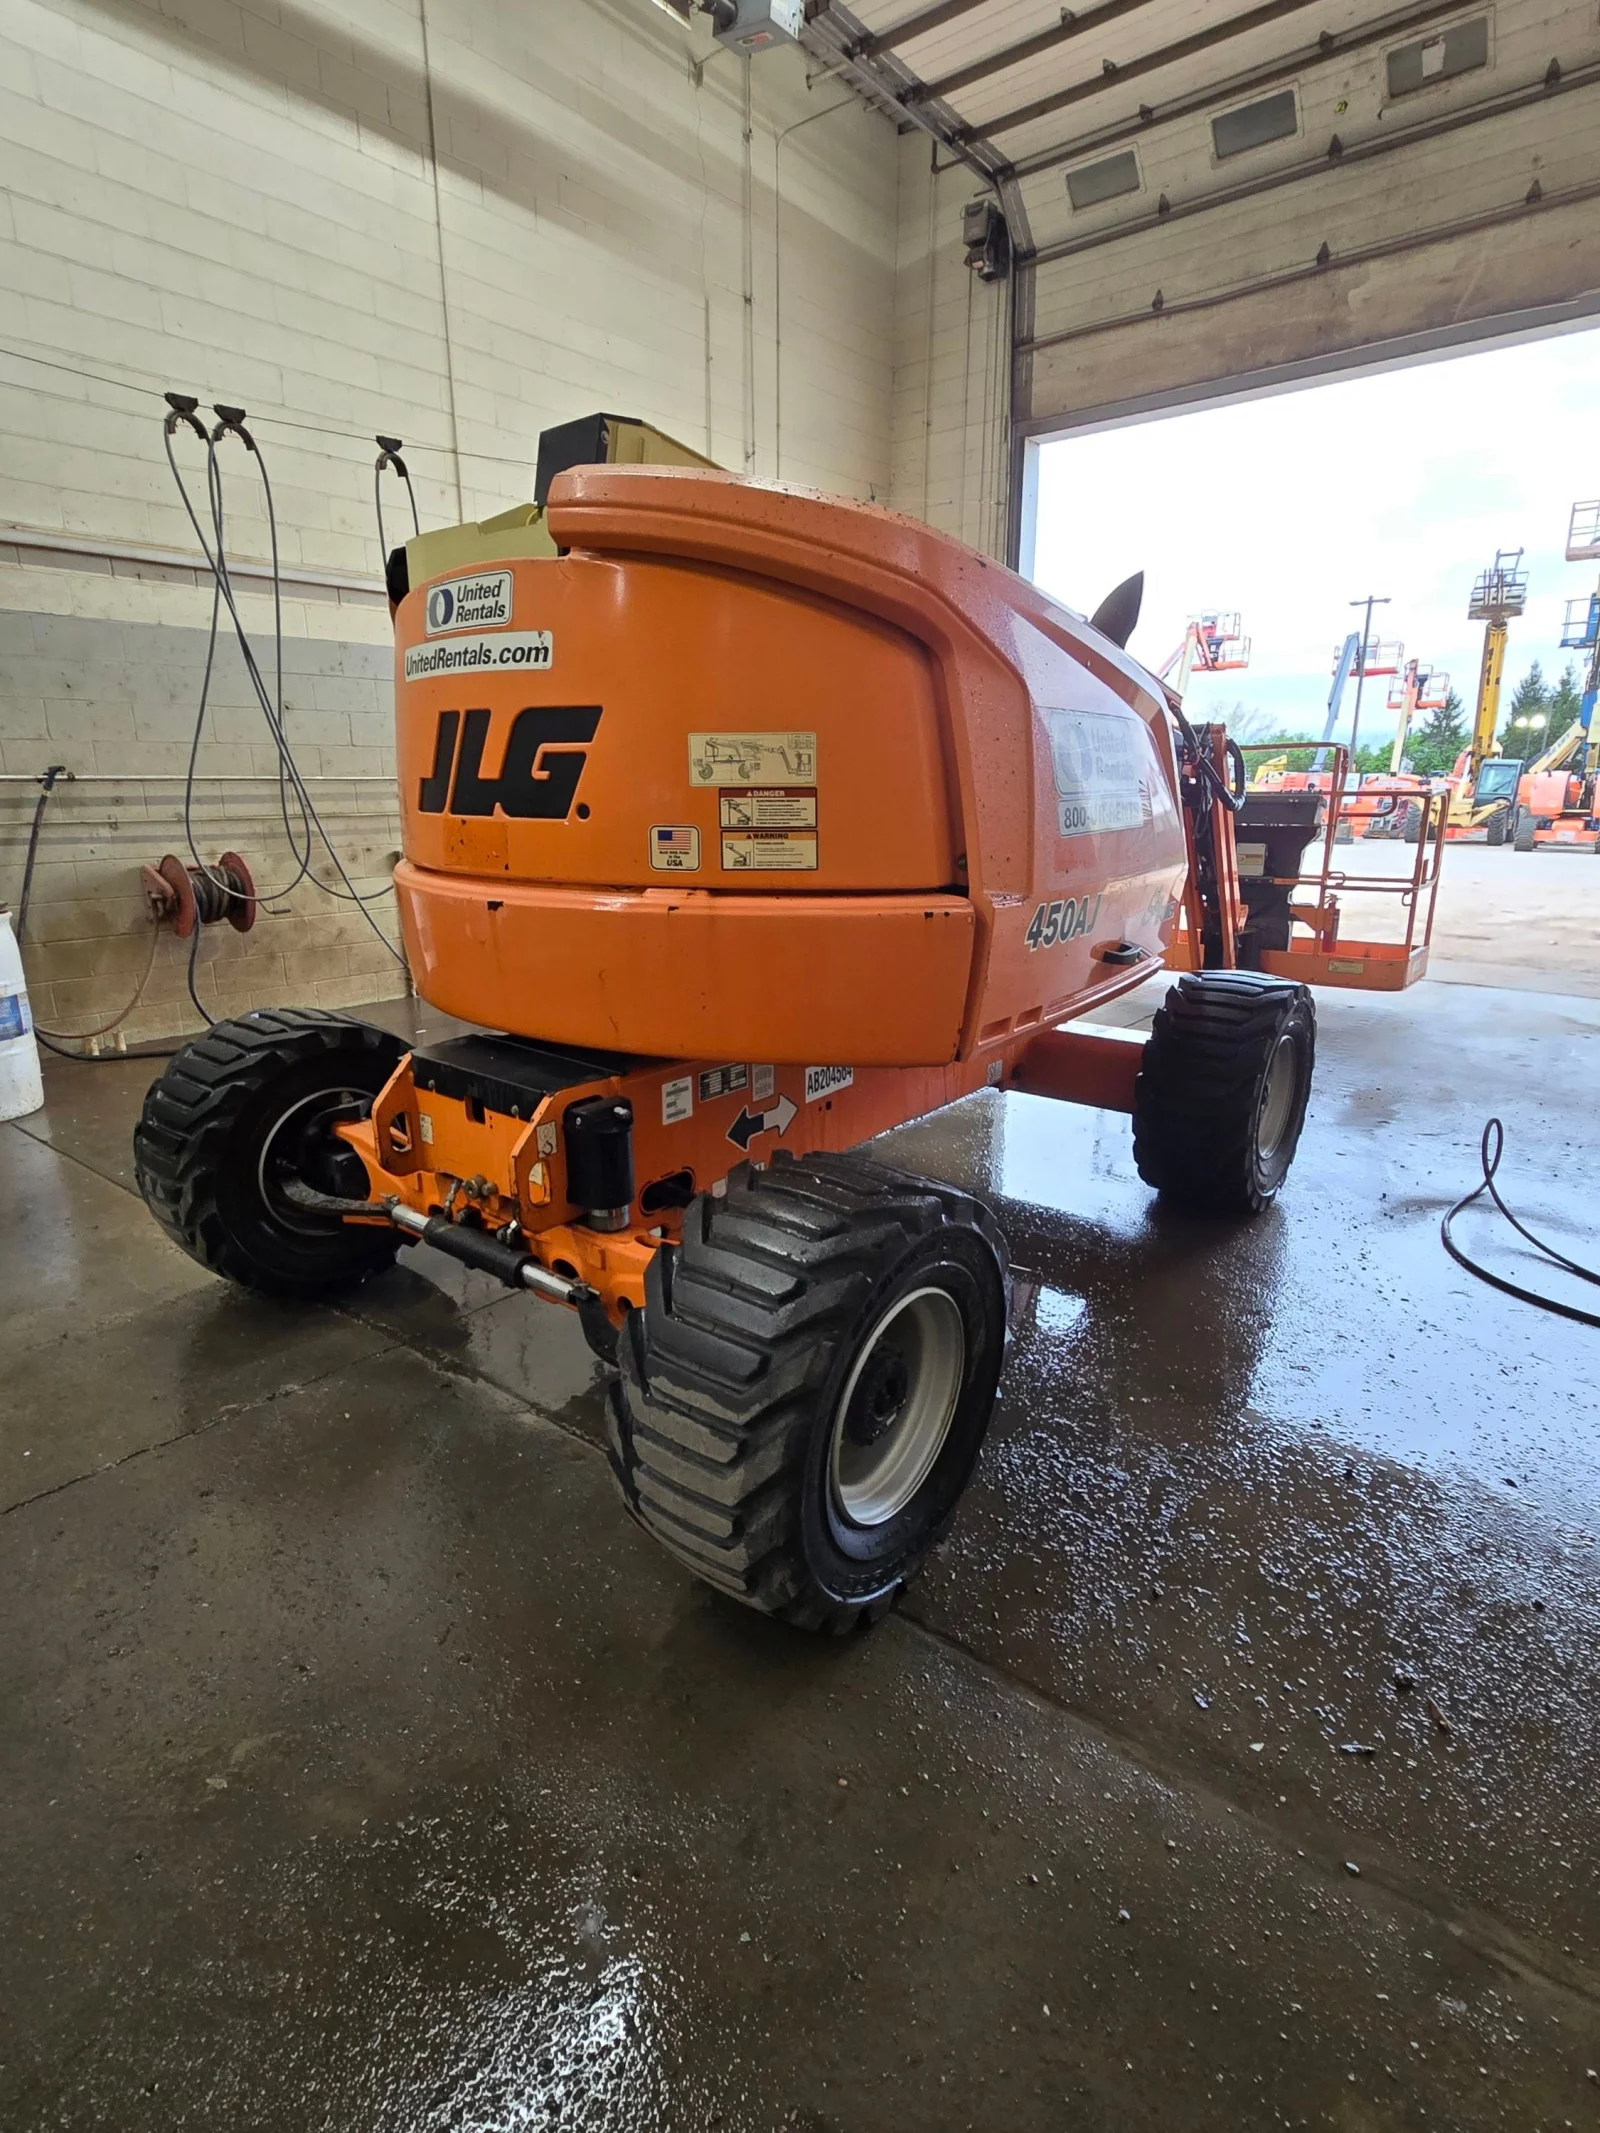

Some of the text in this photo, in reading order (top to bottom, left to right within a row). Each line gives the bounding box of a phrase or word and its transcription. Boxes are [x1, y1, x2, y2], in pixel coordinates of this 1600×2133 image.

[457, 579, 503, 603] United
[455, 600, 506, 623] Rentals
[406, 643, 550, 676] UnitedRentals.com
[666, 859, 683, 867] USA
[1025, 893, 1103, 951] 450AJ
